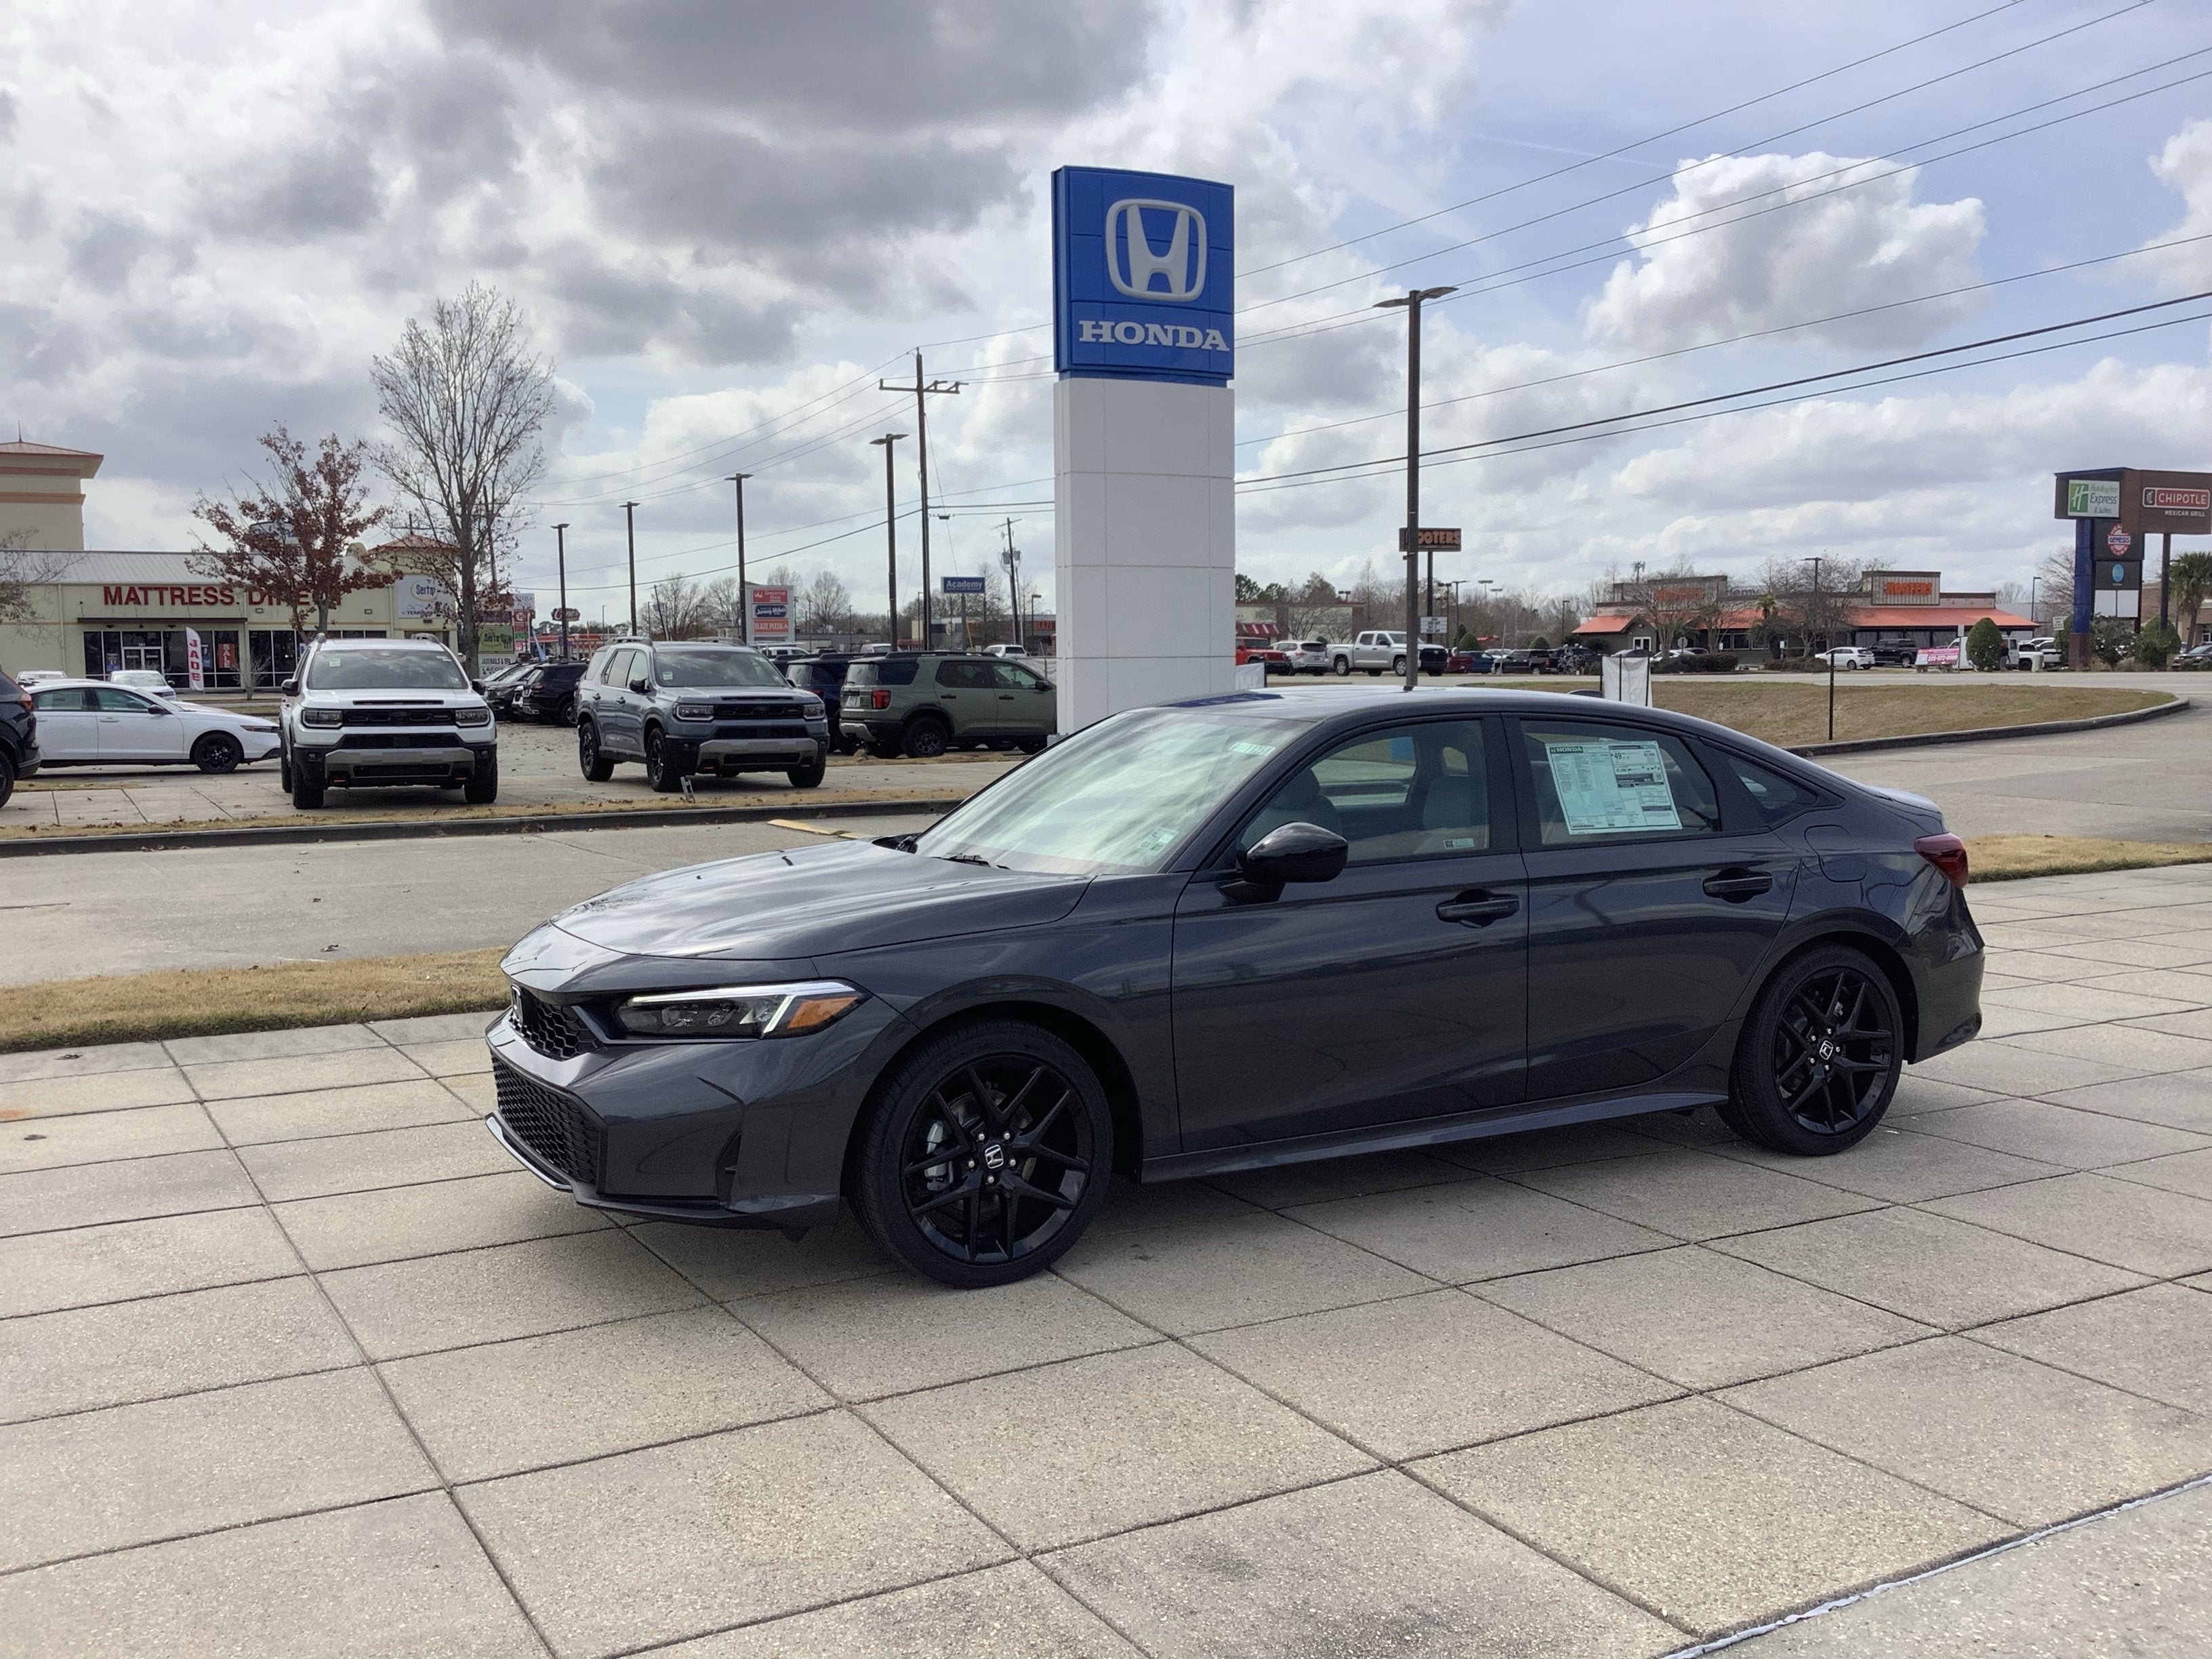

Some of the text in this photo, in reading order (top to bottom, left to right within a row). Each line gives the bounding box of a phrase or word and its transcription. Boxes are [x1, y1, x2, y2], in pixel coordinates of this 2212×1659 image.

[1079, 320, 1230, 352] HONDA
[2090, 493, 2117, 506] Express
[2158, 493, 2207, 505] CHIPOTLE
[1406, 531, 1460, 544] OOTERS
[946, 580, 983, 590] Academy
[104, 586, 235, 606] MATTRESS
[189, 639, 201, 682] JADE
[222, 644, 231, 669] SALE
